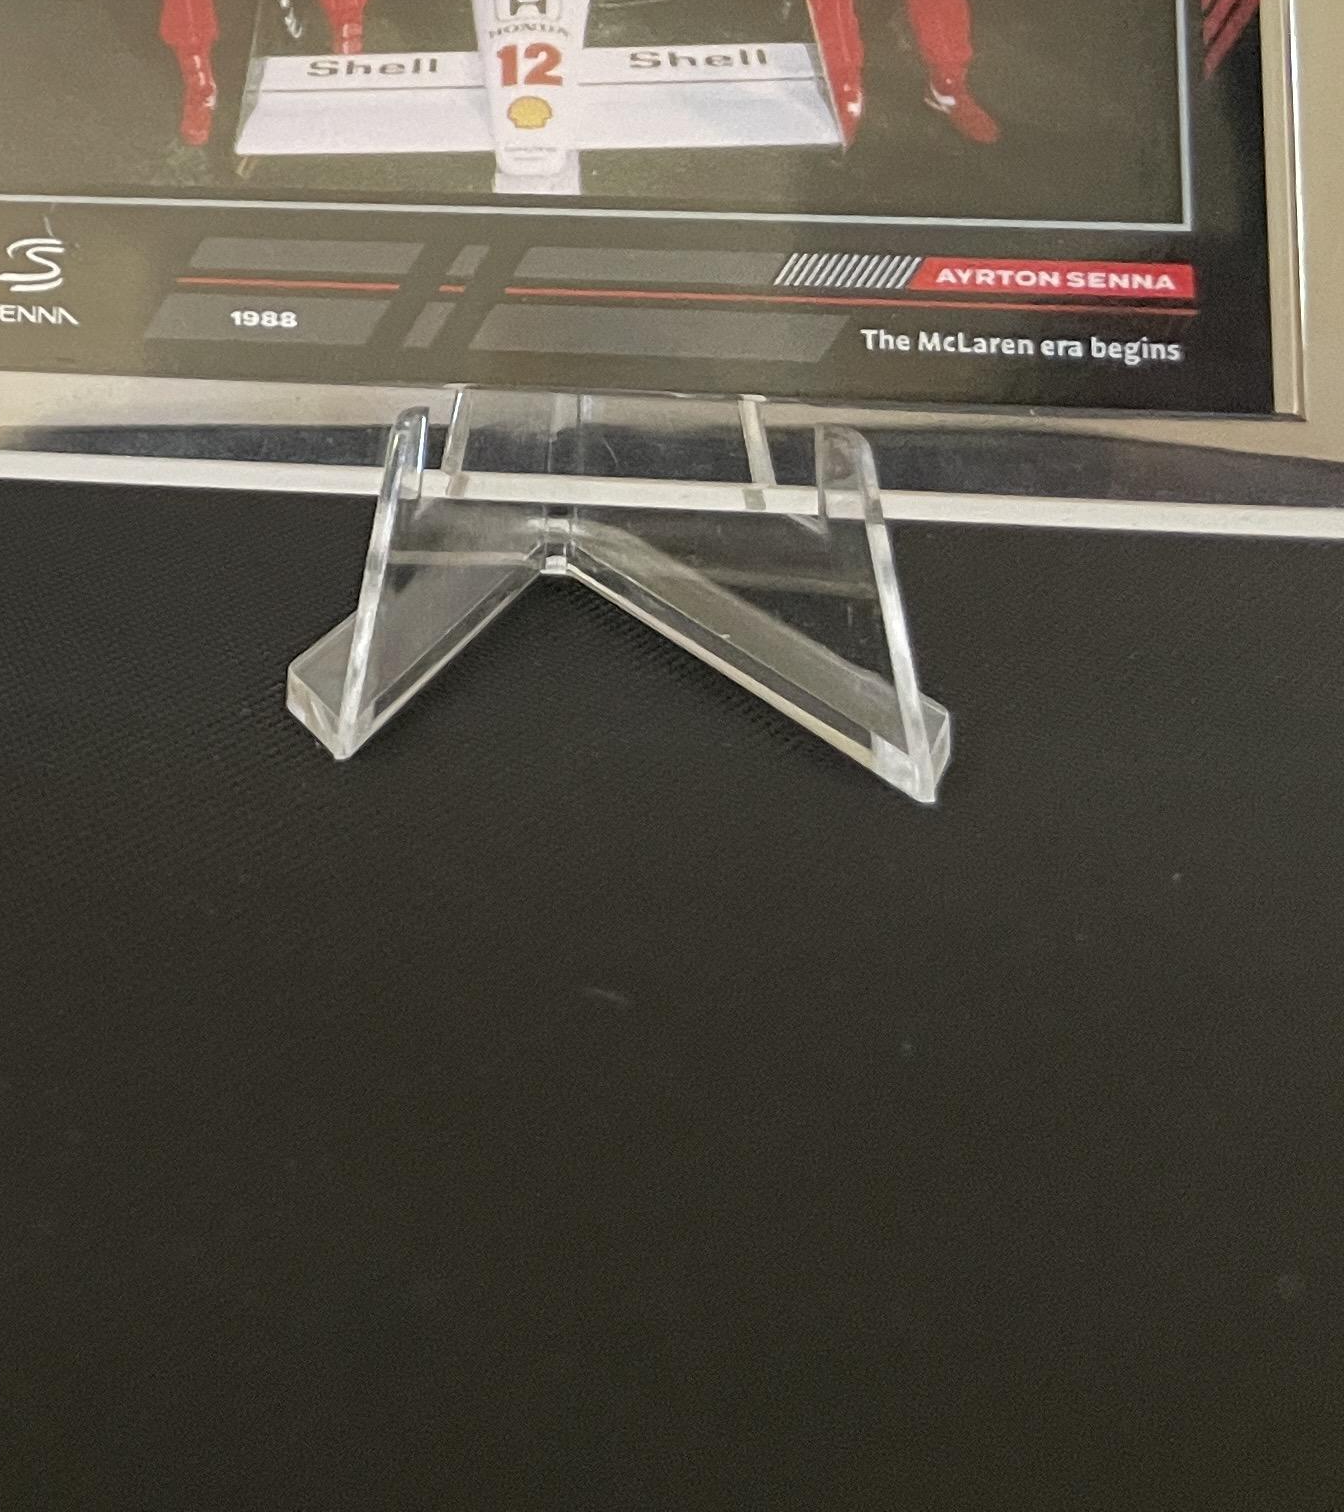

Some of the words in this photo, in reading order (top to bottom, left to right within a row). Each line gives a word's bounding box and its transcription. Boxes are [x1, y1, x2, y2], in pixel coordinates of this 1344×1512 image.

[489, 23, 570, 39] HONDA
[307, 58, 438, 78] Shell
[496, 42, 564, 86] 12
[629, 49, 768, 69] Shell
[936, 267, 1060, 288] AYRTON
[1066, 270, 1177, 291] SENNA
[230, 310, 298, 327] 1988
[860, 329, 911, 351] The
[917, 330, 1035, 356] McLaren
[1040, 338, 1084, 358] era
[1090, 336, 1183, 366] begins
